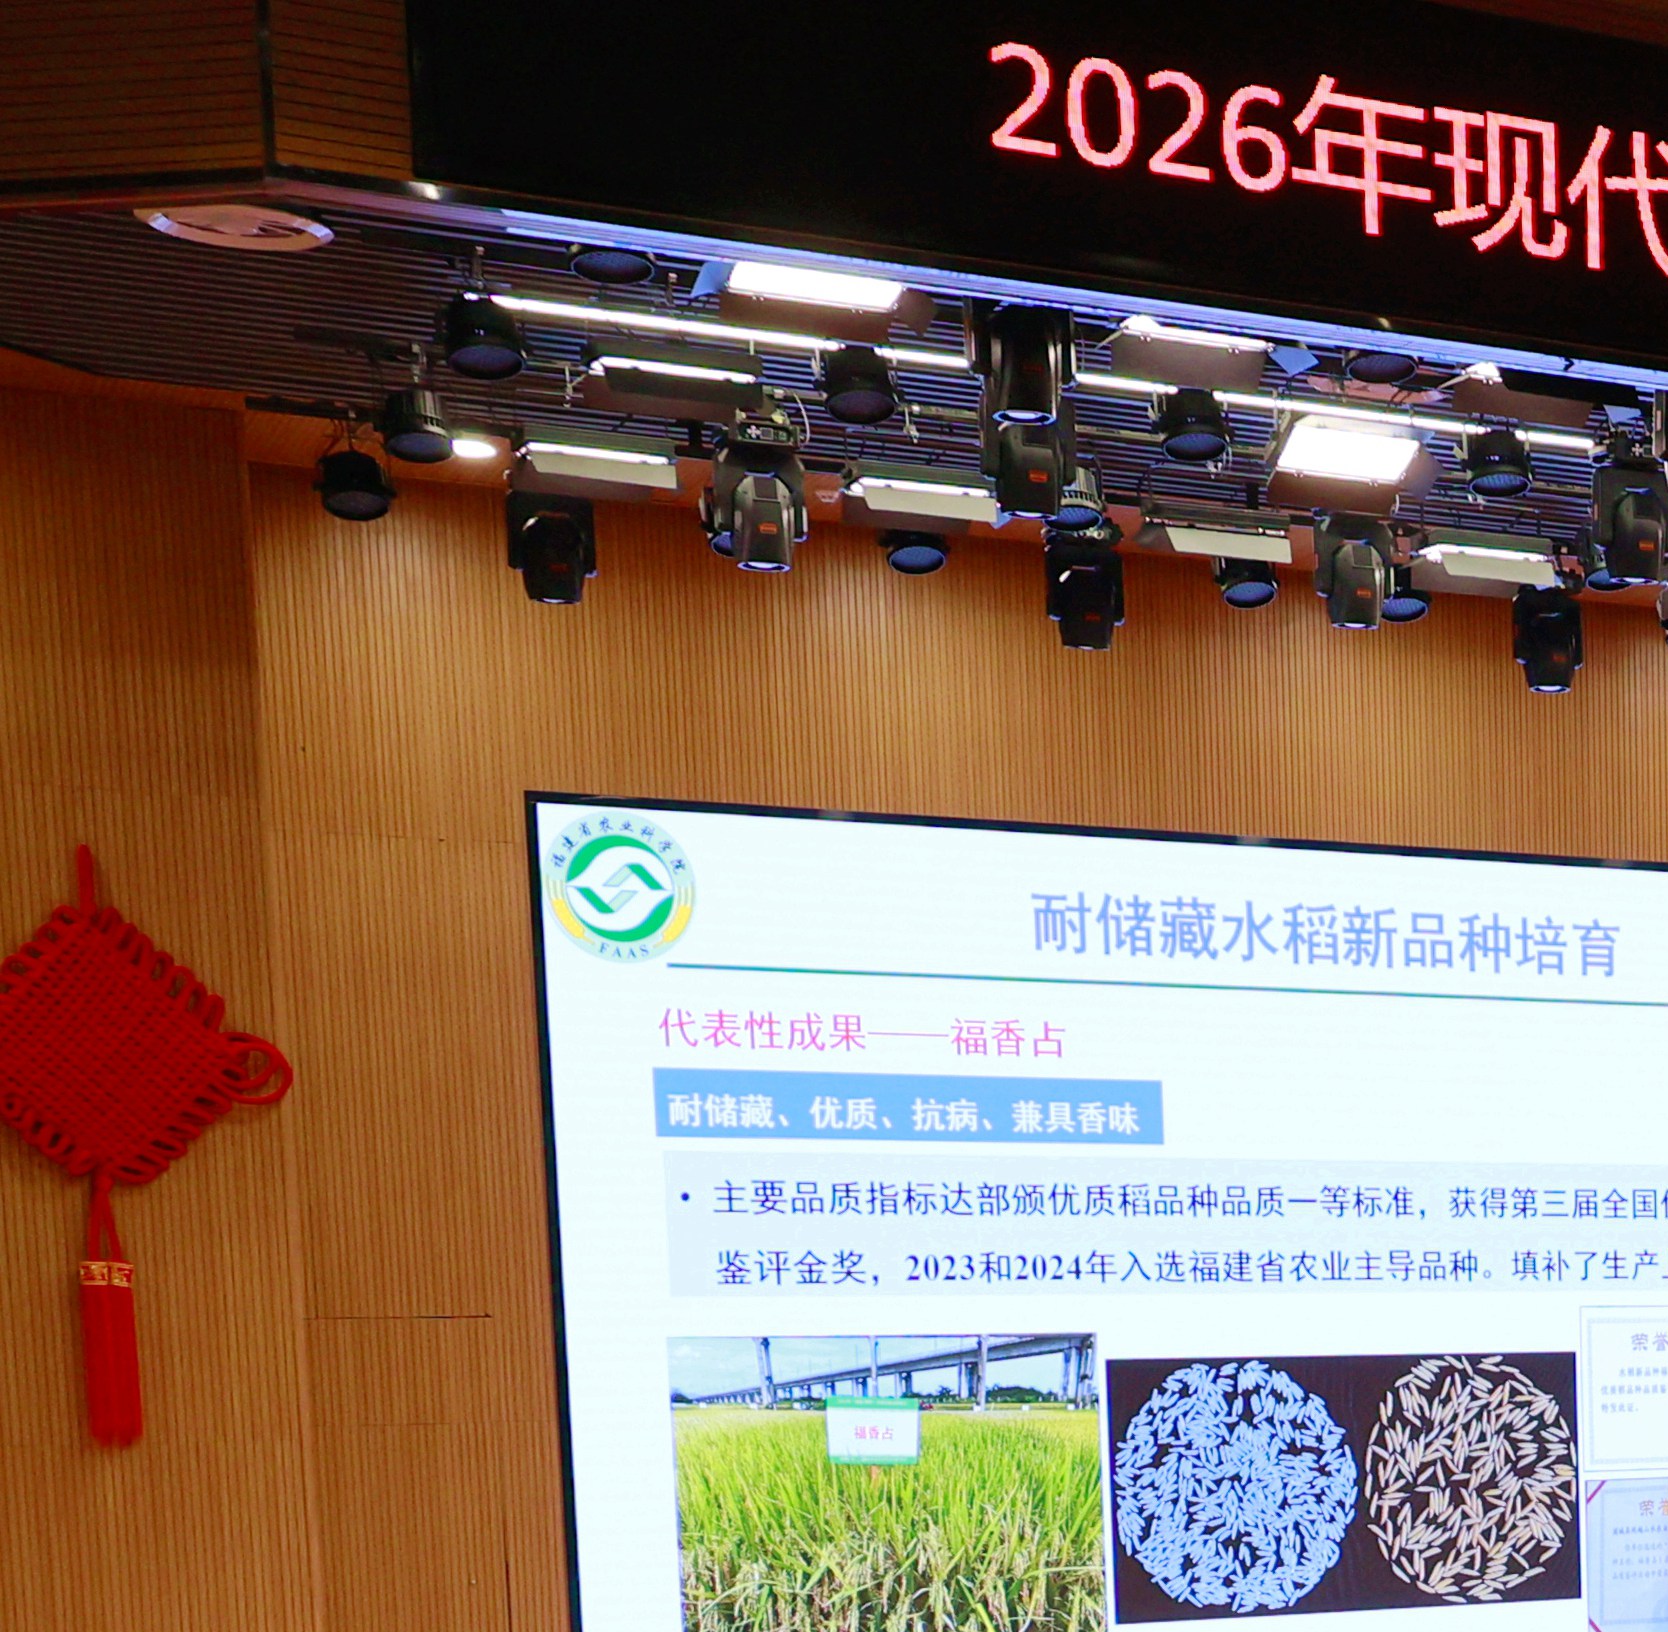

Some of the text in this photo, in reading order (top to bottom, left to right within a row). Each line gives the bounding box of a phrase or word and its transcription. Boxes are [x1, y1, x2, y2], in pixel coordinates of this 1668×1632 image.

[599, 942, 650, 959] FAAS
[1031, 891, 1621, 978] 耐储藏水稻新品种培育
[667, 1092, 1140, 1136] 耐储藏、优质、抗病、兼具香味
